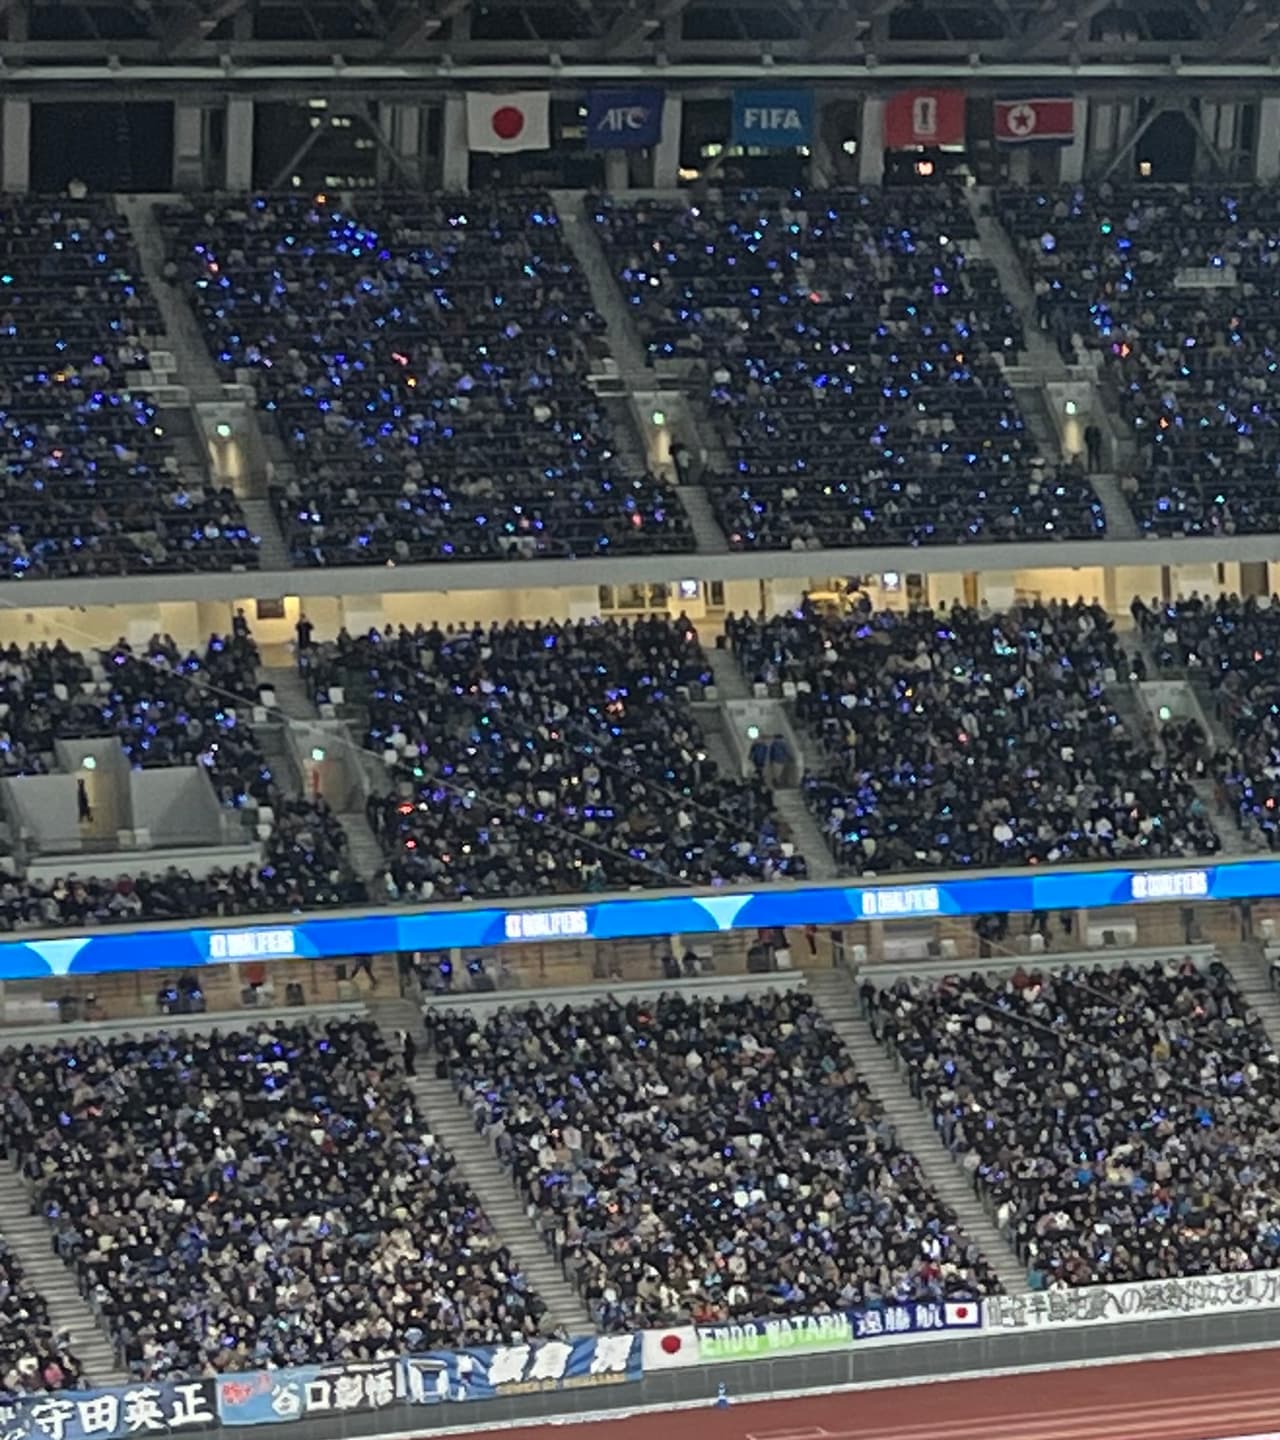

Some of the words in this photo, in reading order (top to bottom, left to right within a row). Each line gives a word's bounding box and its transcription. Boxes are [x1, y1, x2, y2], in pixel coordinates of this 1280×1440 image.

[598, 106, 648, 131] AFC
[744, 108, 801, 130] FIFA
[698, 1326, 758, 1352] ENDO
[31, 1383, 215, 1440] 守田英正
